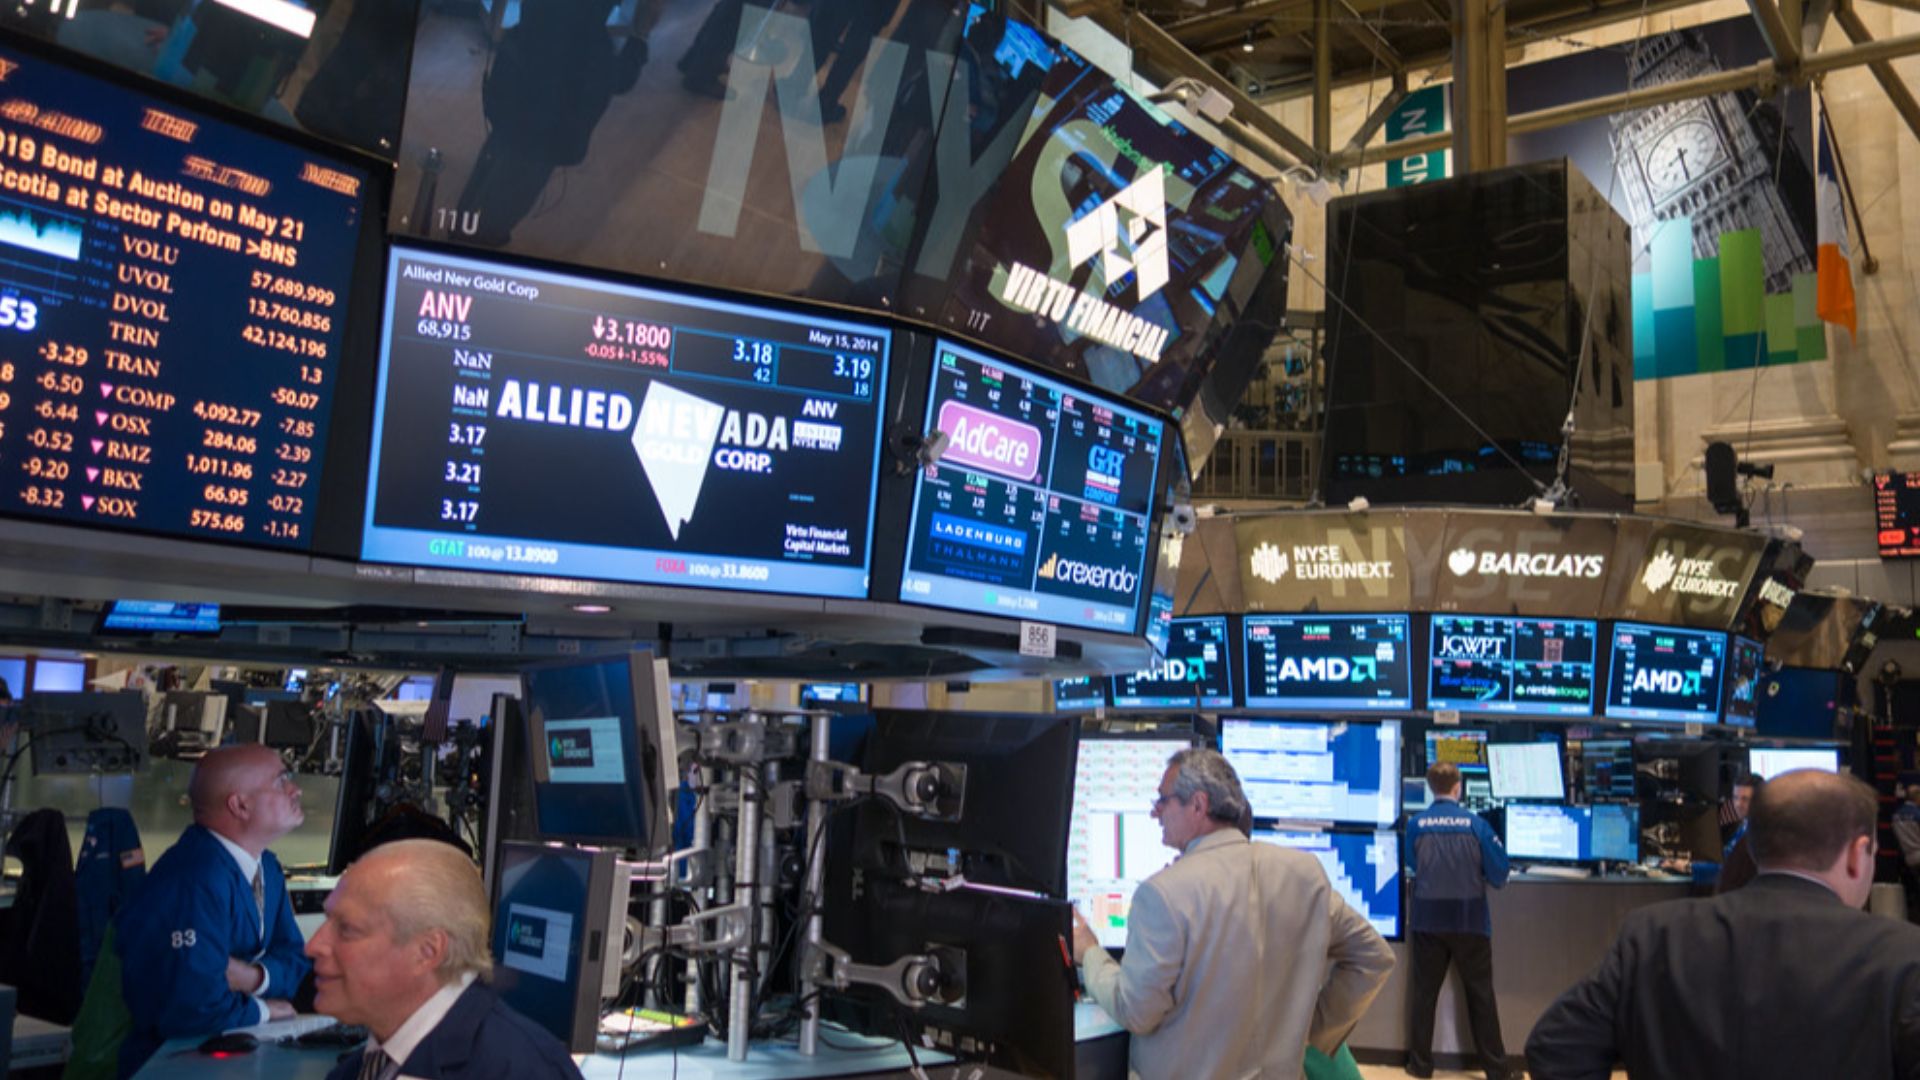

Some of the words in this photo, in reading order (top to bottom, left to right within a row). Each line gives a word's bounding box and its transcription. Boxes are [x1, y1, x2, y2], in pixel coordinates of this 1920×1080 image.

[41, 143, 98, 180] Bond
[102, 165, 126, 190] at
[129, 171, 205, 213] Auction
[209, 198, 234, 221] on
[238, 204, 278, 238] May
[281, 218, 305, 242] 21
[66, 185, 90, 210] at
[94, 190, 162, 230] Sector
[166, 212, 242, 251] Perform
[246, 238, 298, 268] >BNS
[122, 234, 180, 266] VOLU
[117, 263, 174, 294] UVOL
[251, 271, 336, 308] 57,689,999
[403, 265, 443, 284] Allied
[445, 273, 472, 288] Nev
[473, 276, 506, 294] Gold
[507, 281, 539, 301] Corp
[0, 295, 37, 331] 53
[112, 292, 170, 323] DVOL
[249, 297, 331, 332] 13,760,856
[419, 290, 473, 322] ANV
[1003, 261, 1076, 327] VIRTU
[1066, 294, 1170, 364] FINANCIAL
[108, 320, 160, 348] TRIN
[242, 325, 327, 360] 42,124,196
[417, 320, 472, 341] 68,915
[606, 318, 671, 350] 3.1800
[808, 330, 832, 347] May
[834, 333, 850, 350] 15,
[852, 338, 879, 352] 2014
[39, 341, 88, 367] -3.29
[453, 350, 493, 370] NaN
[733, 339, 773, 365] 3.18
[104, 351, 160, 378] TRAN
[300, 365, 323, 385] 1.3
[753, 368, 771, 384] 42
[833, 355, 871, 379] 3.19
[37, 372, 83, 396] -6.50
[453, 385, 489, 408] NaN
[853, 381, 869, 397] 18
[35, 401, 78, 422] -6.44
[115, 385, 175, 412] COMP
[193, 401, 261, 428] 4,092.77
[279, 417, 314, 438] -7.85
[271, 388, 319, 410] -50.07
[802, 399, 838, 419] ANV
[496, 379, 633, 431] ALLIED
[645, 394, 788, 451] NEVADA
[27, 428, 74, 452] -0.52
[111, 413, 152, 436] OSX
[203, 430, 257, 454] 284.06
[275, 444, 311, 464] -2.39
[449, 424, 486, 446] 3.17
[948, 416, 1031, 468] AdCare
[22, 457, 69, 481] -9.20
[106, 440, 152, 464] RMZ
[186, 455, 253, 480] 1,011.96
[271, 469, 307, 489] -2.27
[642, 440, 704, 464] GOLD
[714, 448, 772, 474] CORP.
[445, 461, 481, 484] 3.21
[20, 486, 64, 508] -8.32
[102, 468, 143, 491] BKX
[204, 485, 249, 506] 66.95
[267, 494, 303, 514] -0.72
[97, 495, 138, 518] SOX
[190, 510, 244, 532] 575.66
[263, 519, 300, 539] -1.14
[441, 499, 479, 522] 3.17
[935, 521, 1023, 548] LADENBURG
[429, 538, 465, 557] GTAT
[1293, 545, 1340, 561] NYSE
[655, 557, 687, 574] FOXA
[1056, 558, 1136, 593] crexendo
[1478, 552, 1604, 578] BARCLAYS
[1678, 558, 1714, 575] NYSE
[1028, 626, 1049, 643] 856
[1278, 657, 1350, 681] AMD
[1633, 668, 1684, 693] AMD
[1426, 816, 1472, 828] BARCLAYS
[171, 929, 197, 948] 83
